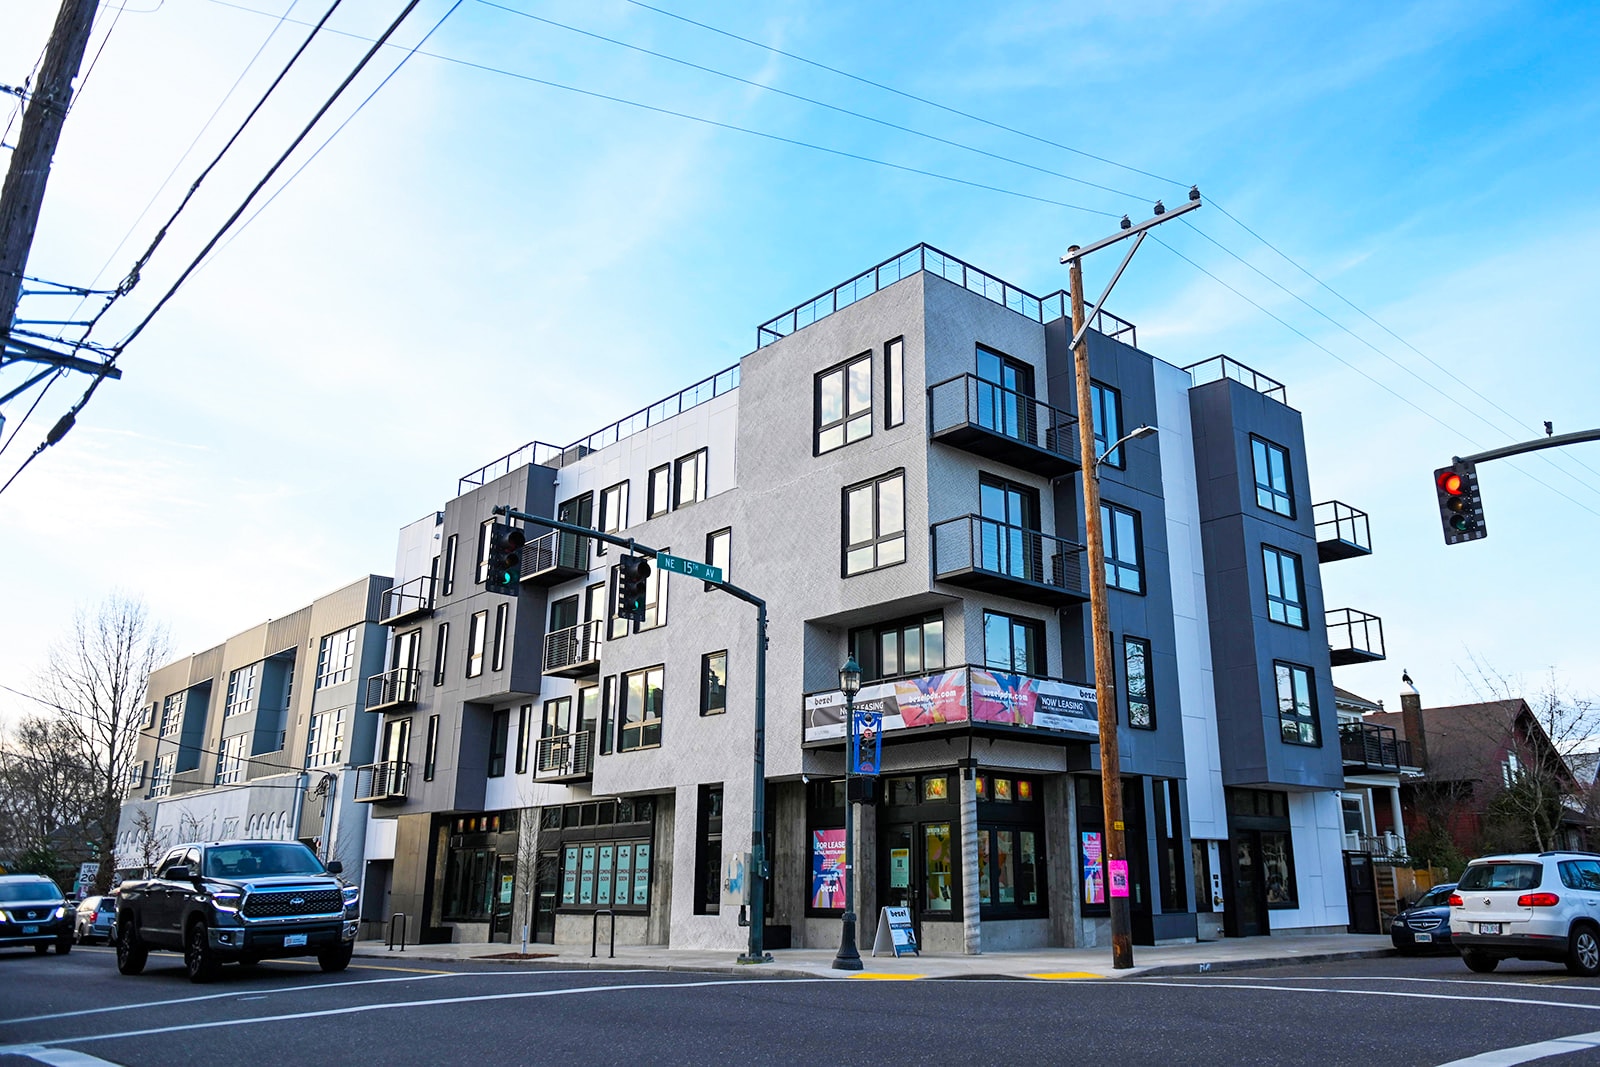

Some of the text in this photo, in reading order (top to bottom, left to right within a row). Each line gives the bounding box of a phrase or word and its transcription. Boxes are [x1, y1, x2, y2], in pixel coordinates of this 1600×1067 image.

[665, 557, 715, 578] NE 15TH AV
[814, 694, 833, 706] bezel
[908, 688, 957, 704] bezelpdx.com
[982, 687, 1029, 702] bezelpdx.com
[1041, 697, 1057, 707] NOW
[1058, 698, 1084, 711] LEASING
[816, 840, 846, 849] FOR LEASE
[80, 873, 96, 883] 20
